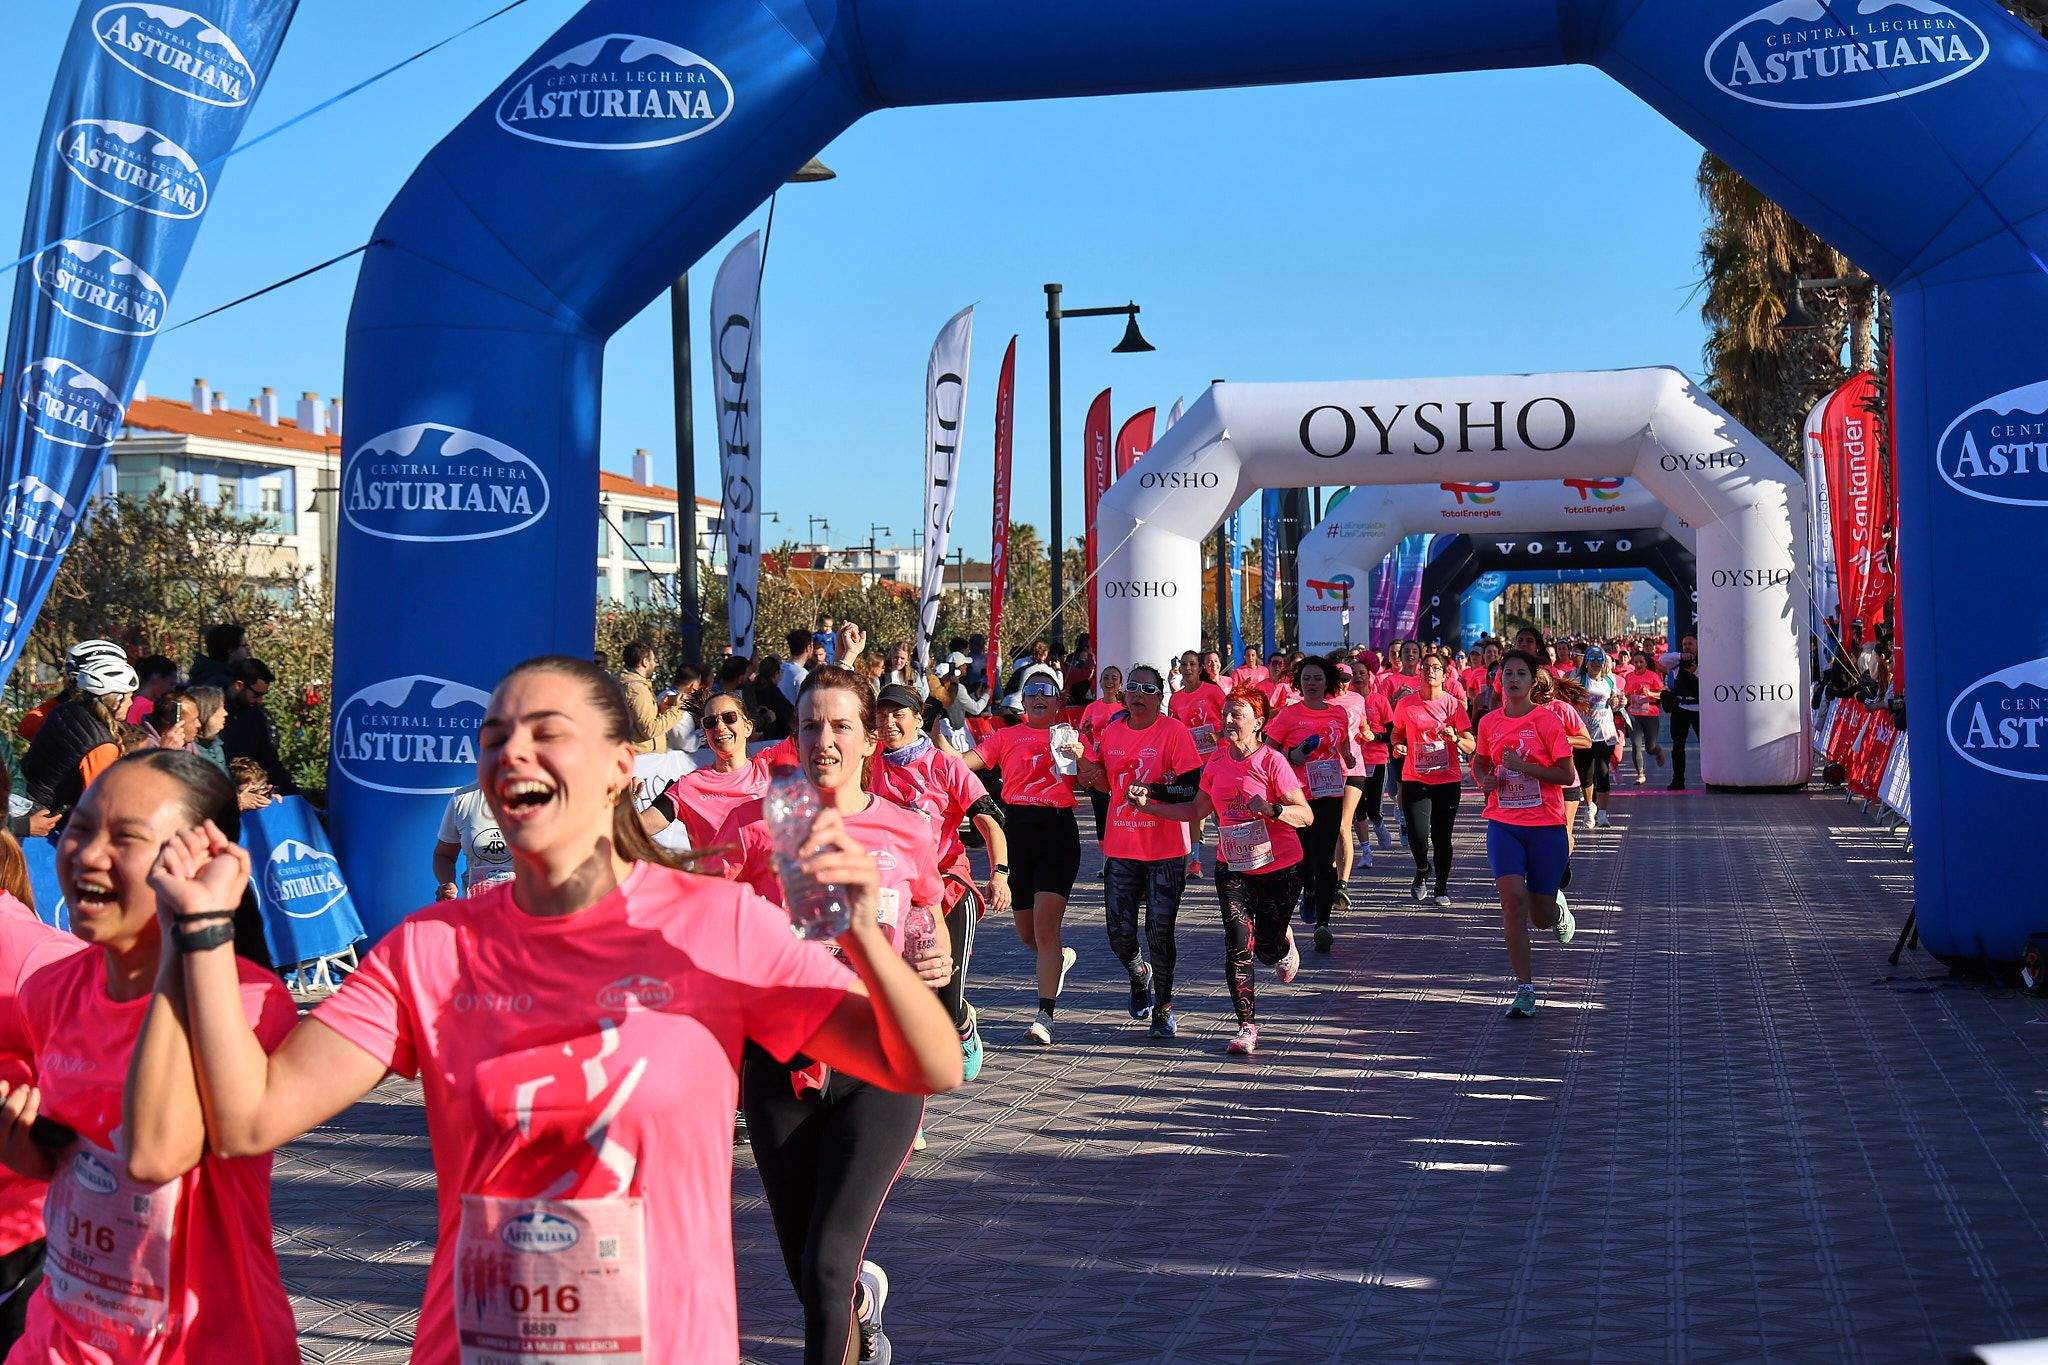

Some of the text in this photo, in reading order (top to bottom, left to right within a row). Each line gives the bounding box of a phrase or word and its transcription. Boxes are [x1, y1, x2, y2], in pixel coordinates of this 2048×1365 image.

[1767, 19, 1957, 46] CENTRAL LECHERA
[102, 14, 241, 100] ASTURIANA
[138, 21, 245, 77] CENTRAL LECHERA
[1728, 34, 1974, 86] ASTURIANA
[547, 71, 707, 87] CENTRAL LECHERA
[508, 84, 715, 122] ASTURIANA
[67, 131, 197, 212] ASTURIANA
[1299, 397, 1576, 458] OYSHO
[1660, 451, 1746, 472] OYSHO
[371, 464, 527, 480] CENTRAL LECHERA
[1140, 472, 1219, 489] OYSHO
[1845, 416, 1869, 542] Santander
[350, 467, 534, 515] ASTURIANA
[1440, 510, 1503, 518] TotalEnergies
[1563, 504, 1626, 514] TotalEnergies
[1496, 540, 1632, 555] VOLVO
[1711, 568, 1791, 588] OYSHO
[1105, 581, 1177, 598] OYSHO
[1306, 604, 1355, 613] TotalEnerges
[1714, 683, 1794, 703] OYSHO
[362, 715, 483, 729] CENTRAL LECH
[339, 717, 478, 764] ASTURIA
[509, 1284, 580, 1314] 016
[574, 1340, 620, 1350] VALENCIA
